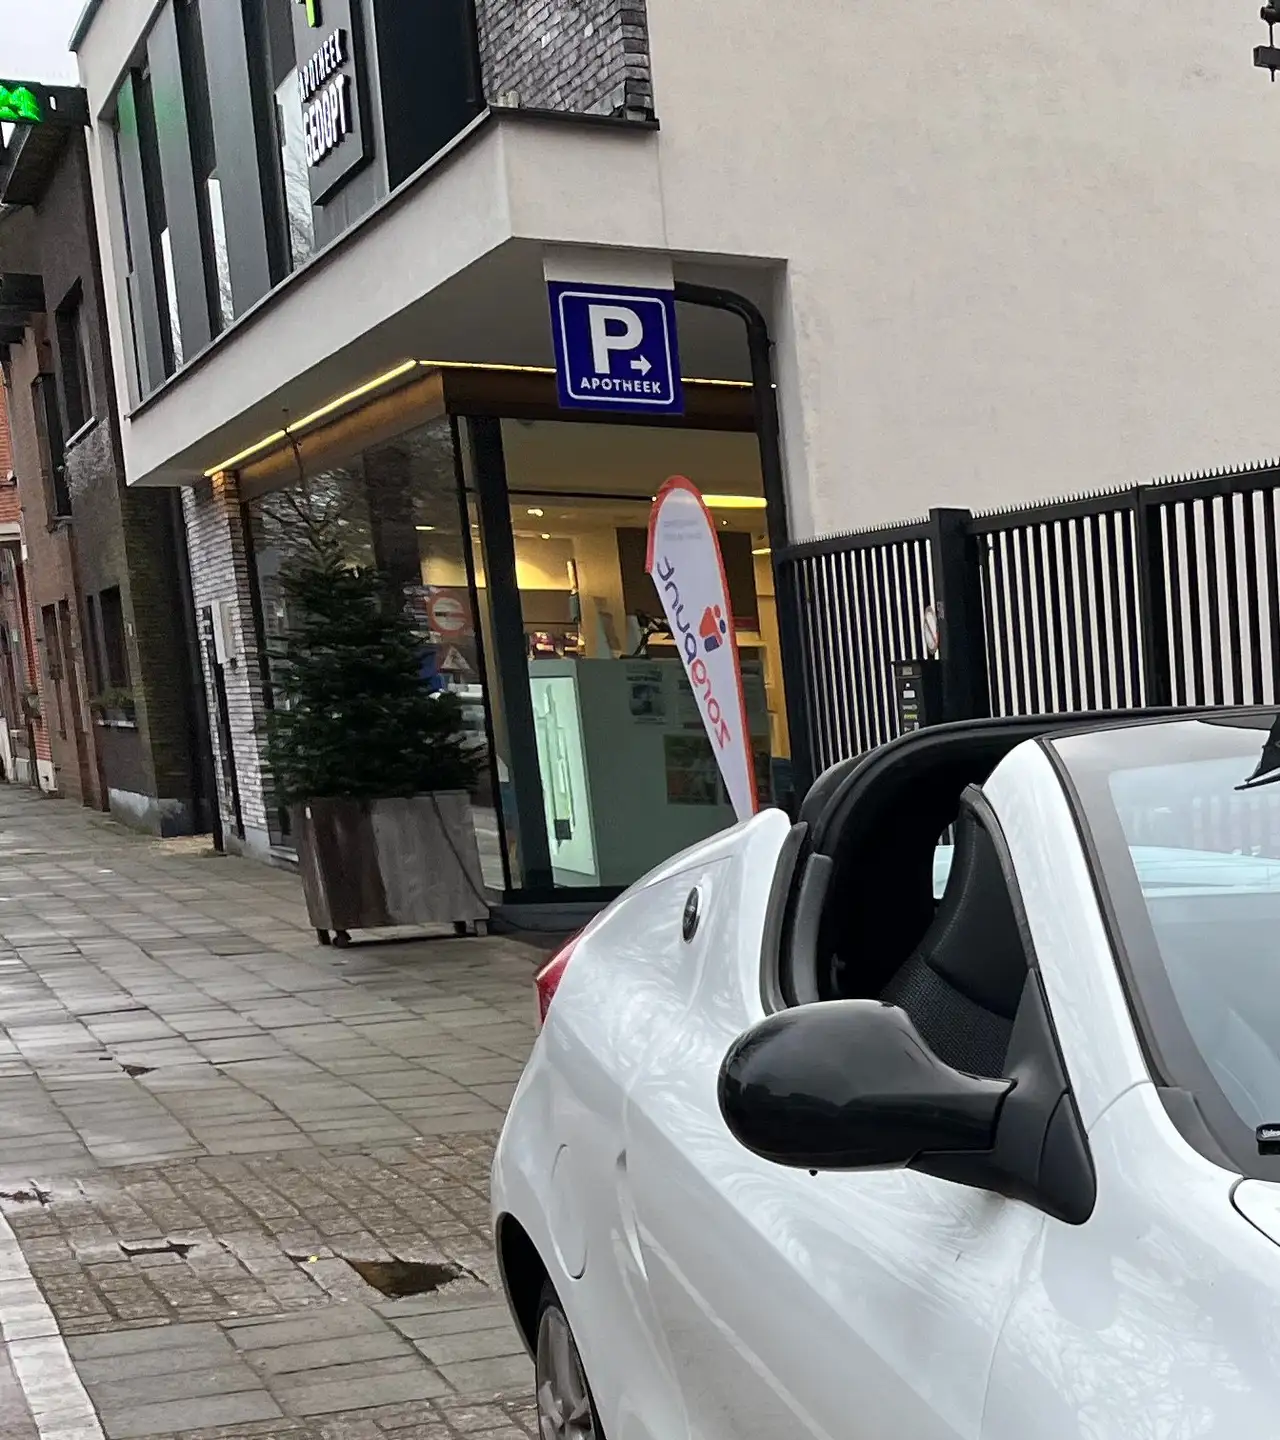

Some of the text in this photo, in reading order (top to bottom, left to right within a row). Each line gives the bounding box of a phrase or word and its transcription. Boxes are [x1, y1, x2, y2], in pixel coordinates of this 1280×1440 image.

[299, 28, 343, 103] APOTHEEK
[588, 304, 644, 374] P
[580, 377, 662, 394] APOTHEEK
